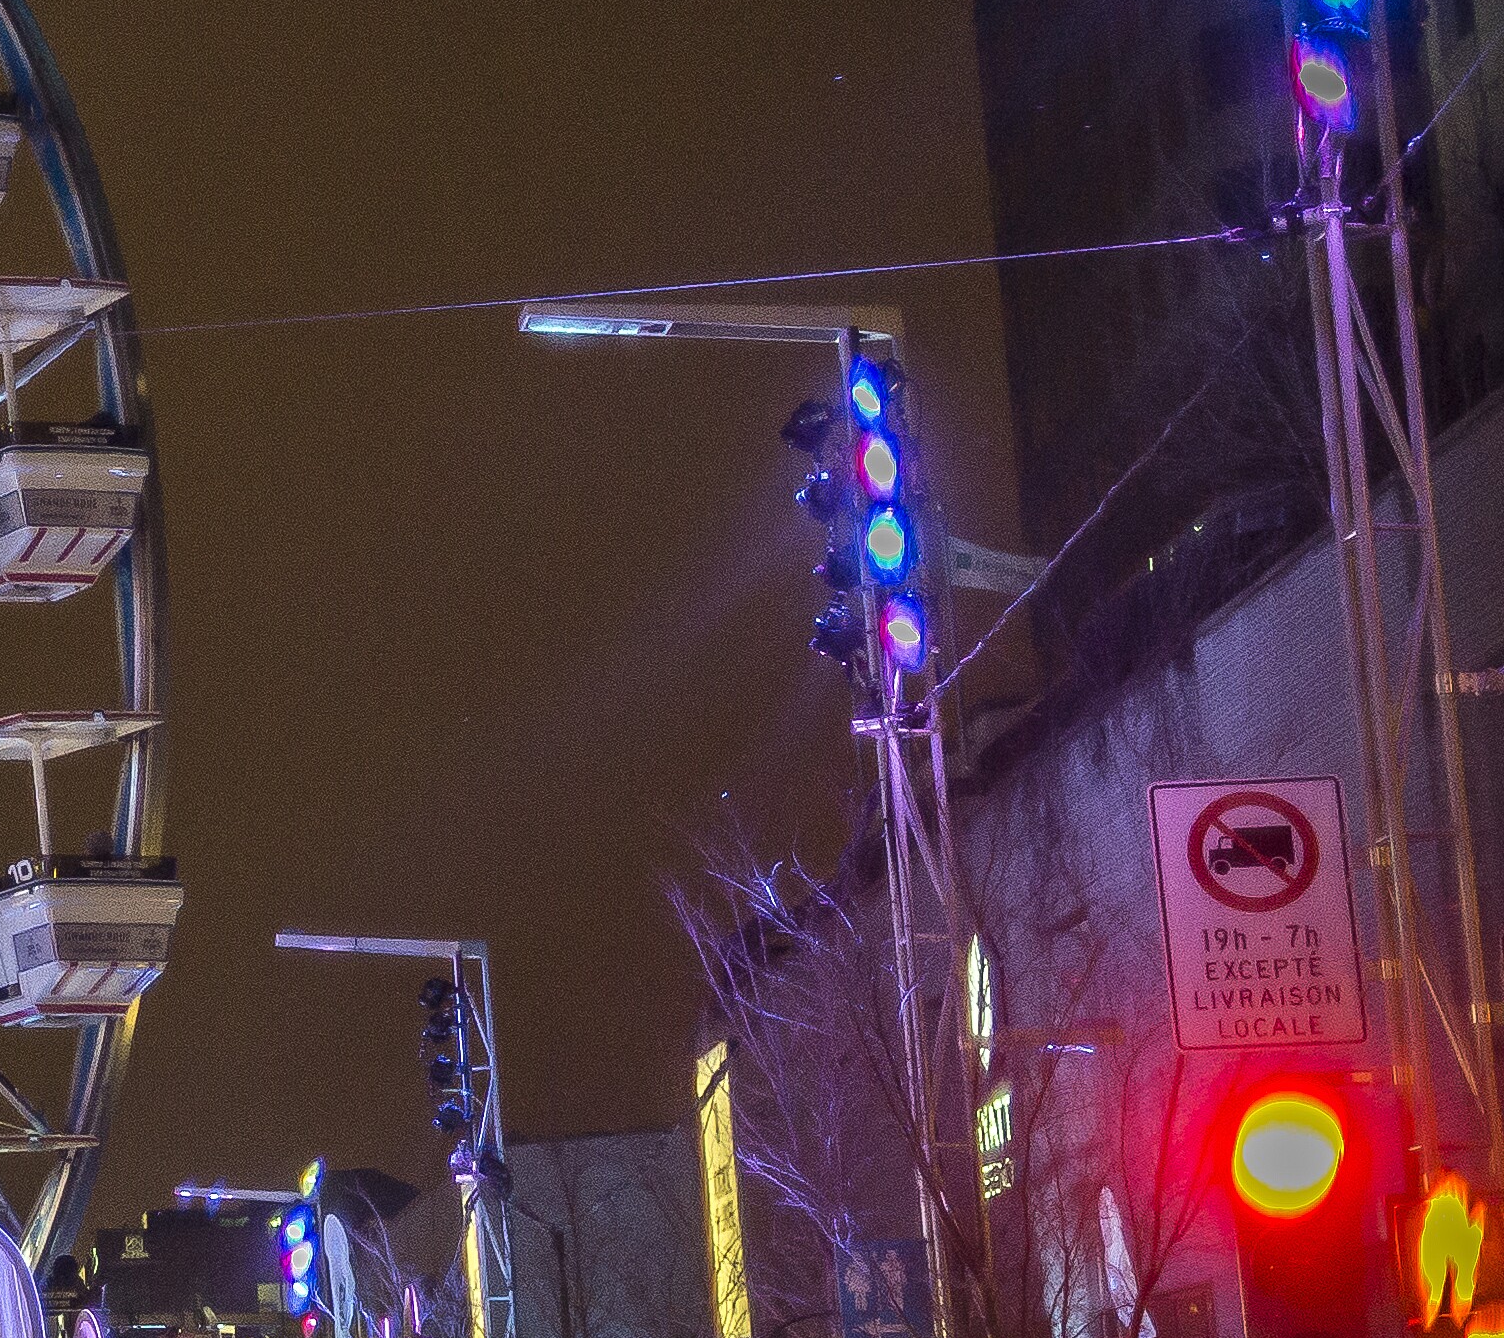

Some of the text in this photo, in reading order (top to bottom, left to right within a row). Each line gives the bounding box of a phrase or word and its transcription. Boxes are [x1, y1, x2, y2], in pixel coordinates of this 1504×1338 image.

[7, 859, 32, 883] 10
[1203, 928, 1247, 953] 19h
[1286, 925, 1319, 948] 7h
[1205, 951, 1323, 981] EXCEPTÉ
[1194, 984, 1341, 1010] LIVRAISON
[1218, 1015, 1324, 1039] LOCALE
